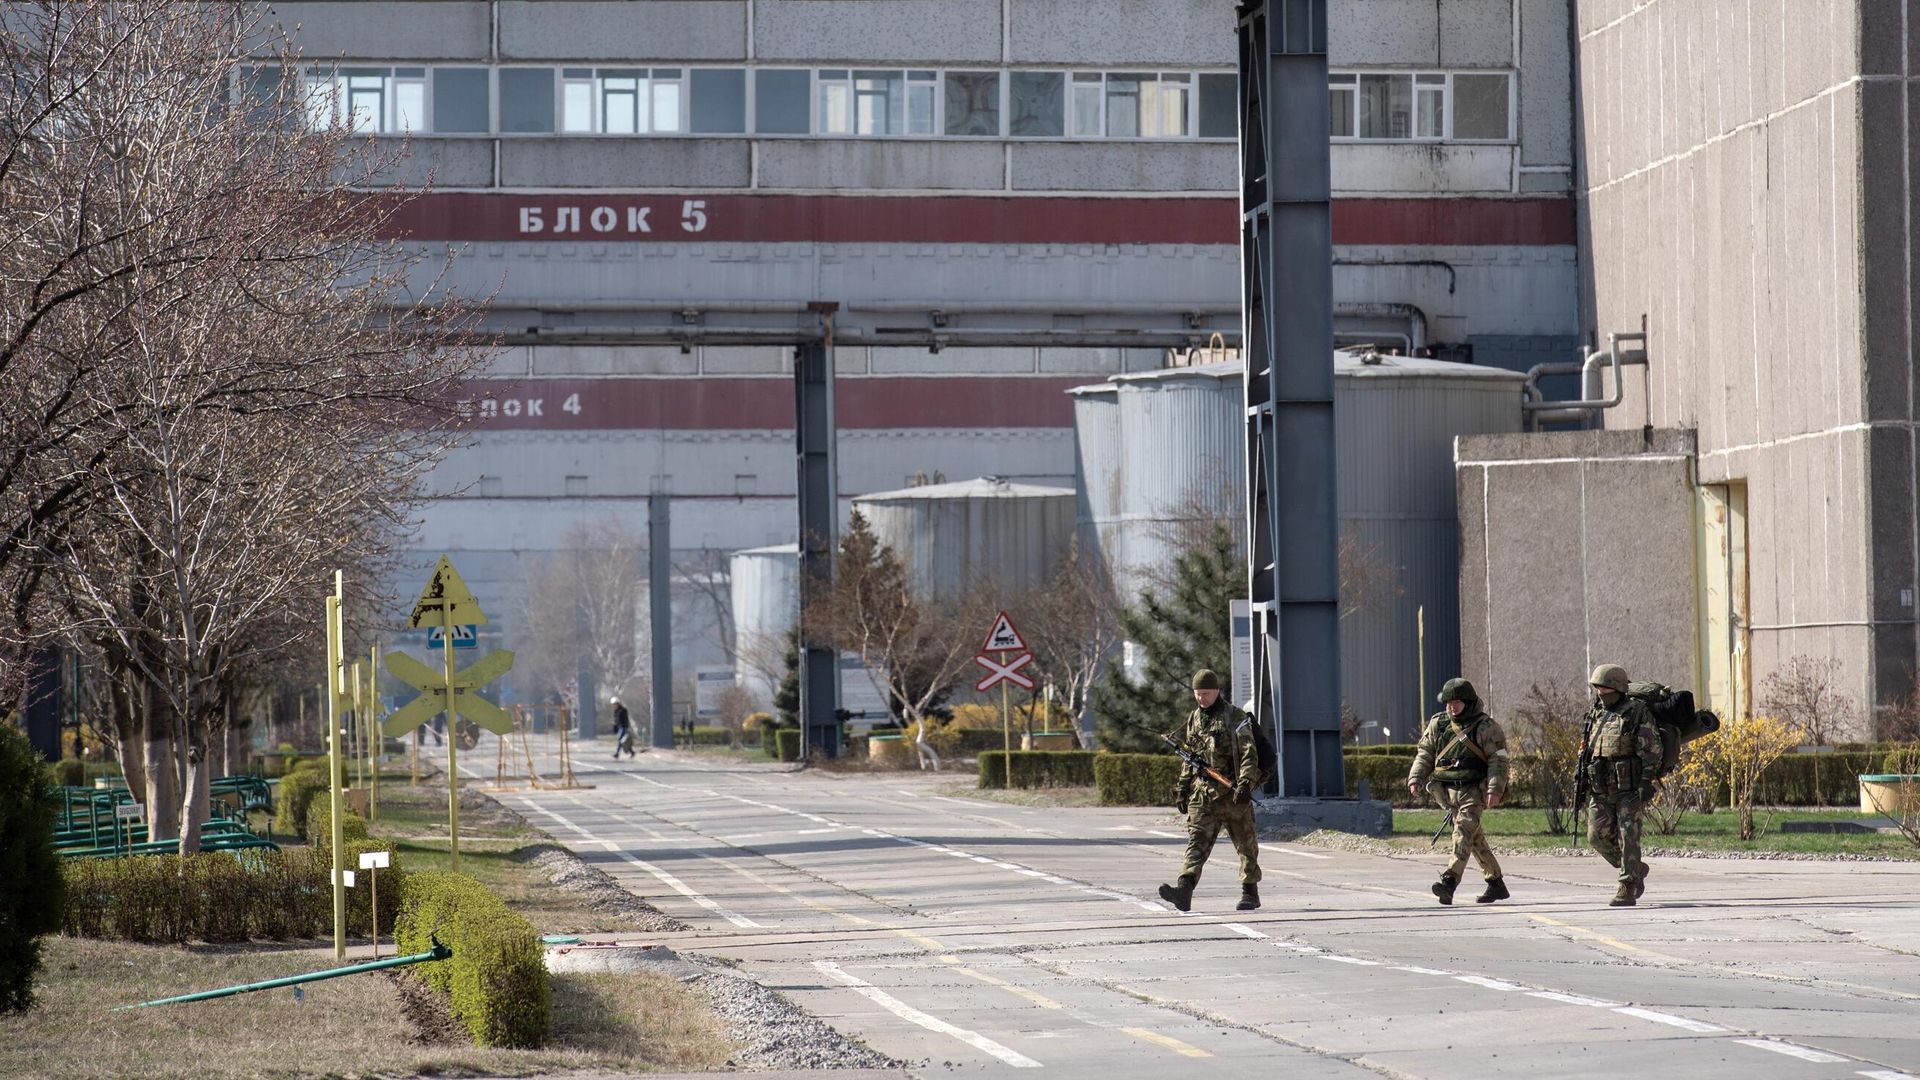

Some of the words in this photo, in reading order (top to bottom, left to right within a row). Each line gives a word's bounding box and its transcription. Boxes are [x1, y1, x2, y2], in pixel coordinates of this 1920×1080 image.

[519, 206, 652, 233] БЛОК
[680, 199, 708, 232] 5
[562, 393, 582, 415] 4
